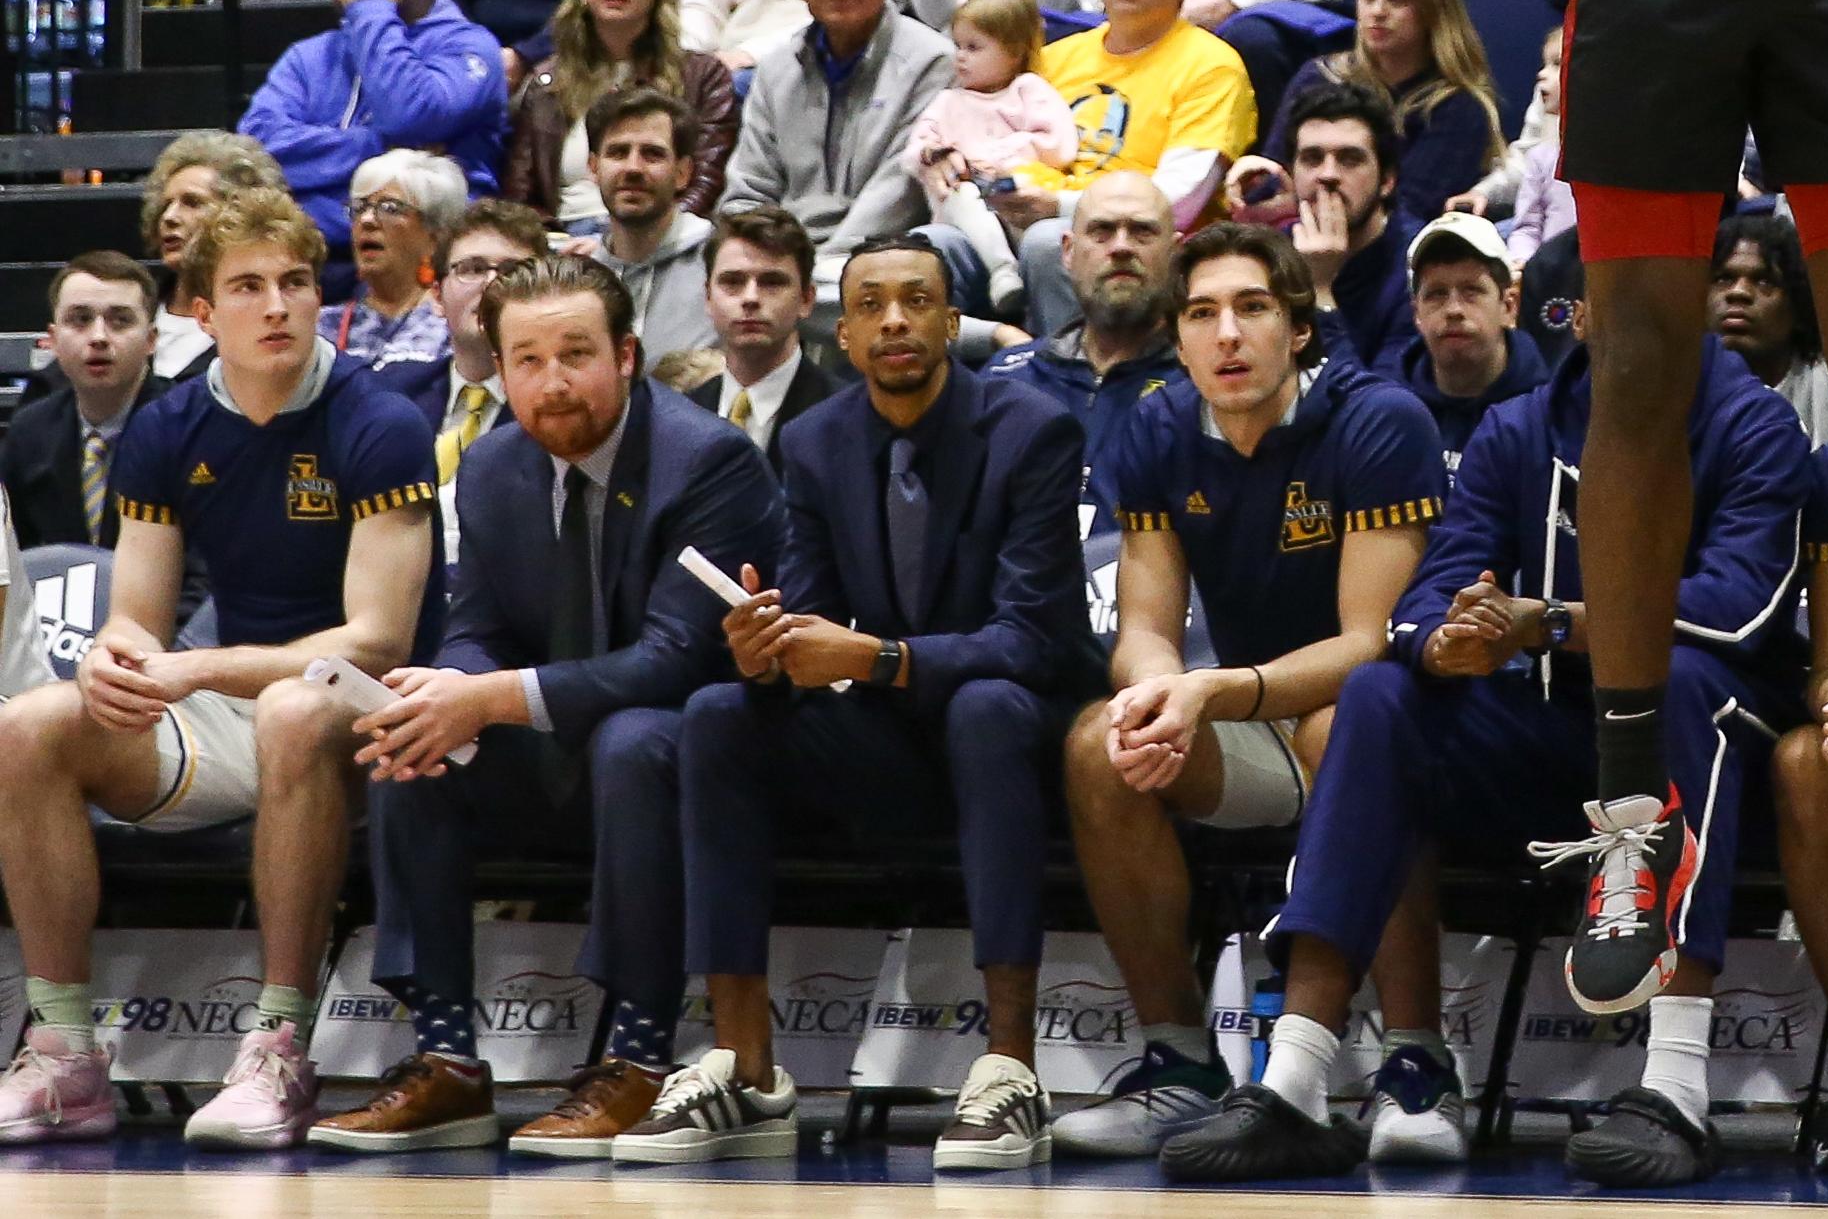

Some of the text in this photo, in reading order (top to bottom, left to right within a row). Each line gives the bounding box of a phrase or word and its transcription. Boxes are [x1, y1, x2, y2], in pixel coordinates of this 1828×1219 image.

[121, 996, 172, 1032] 98
[328, 998, 402, 1019] IBEW
[474, 998, 579, 1032] NECA
[874, 1006, 942, 1026] IBEW
[1037, 1007, 1128, 1044] ECA
[1524, 1018, 1596, 1039] IBEW
